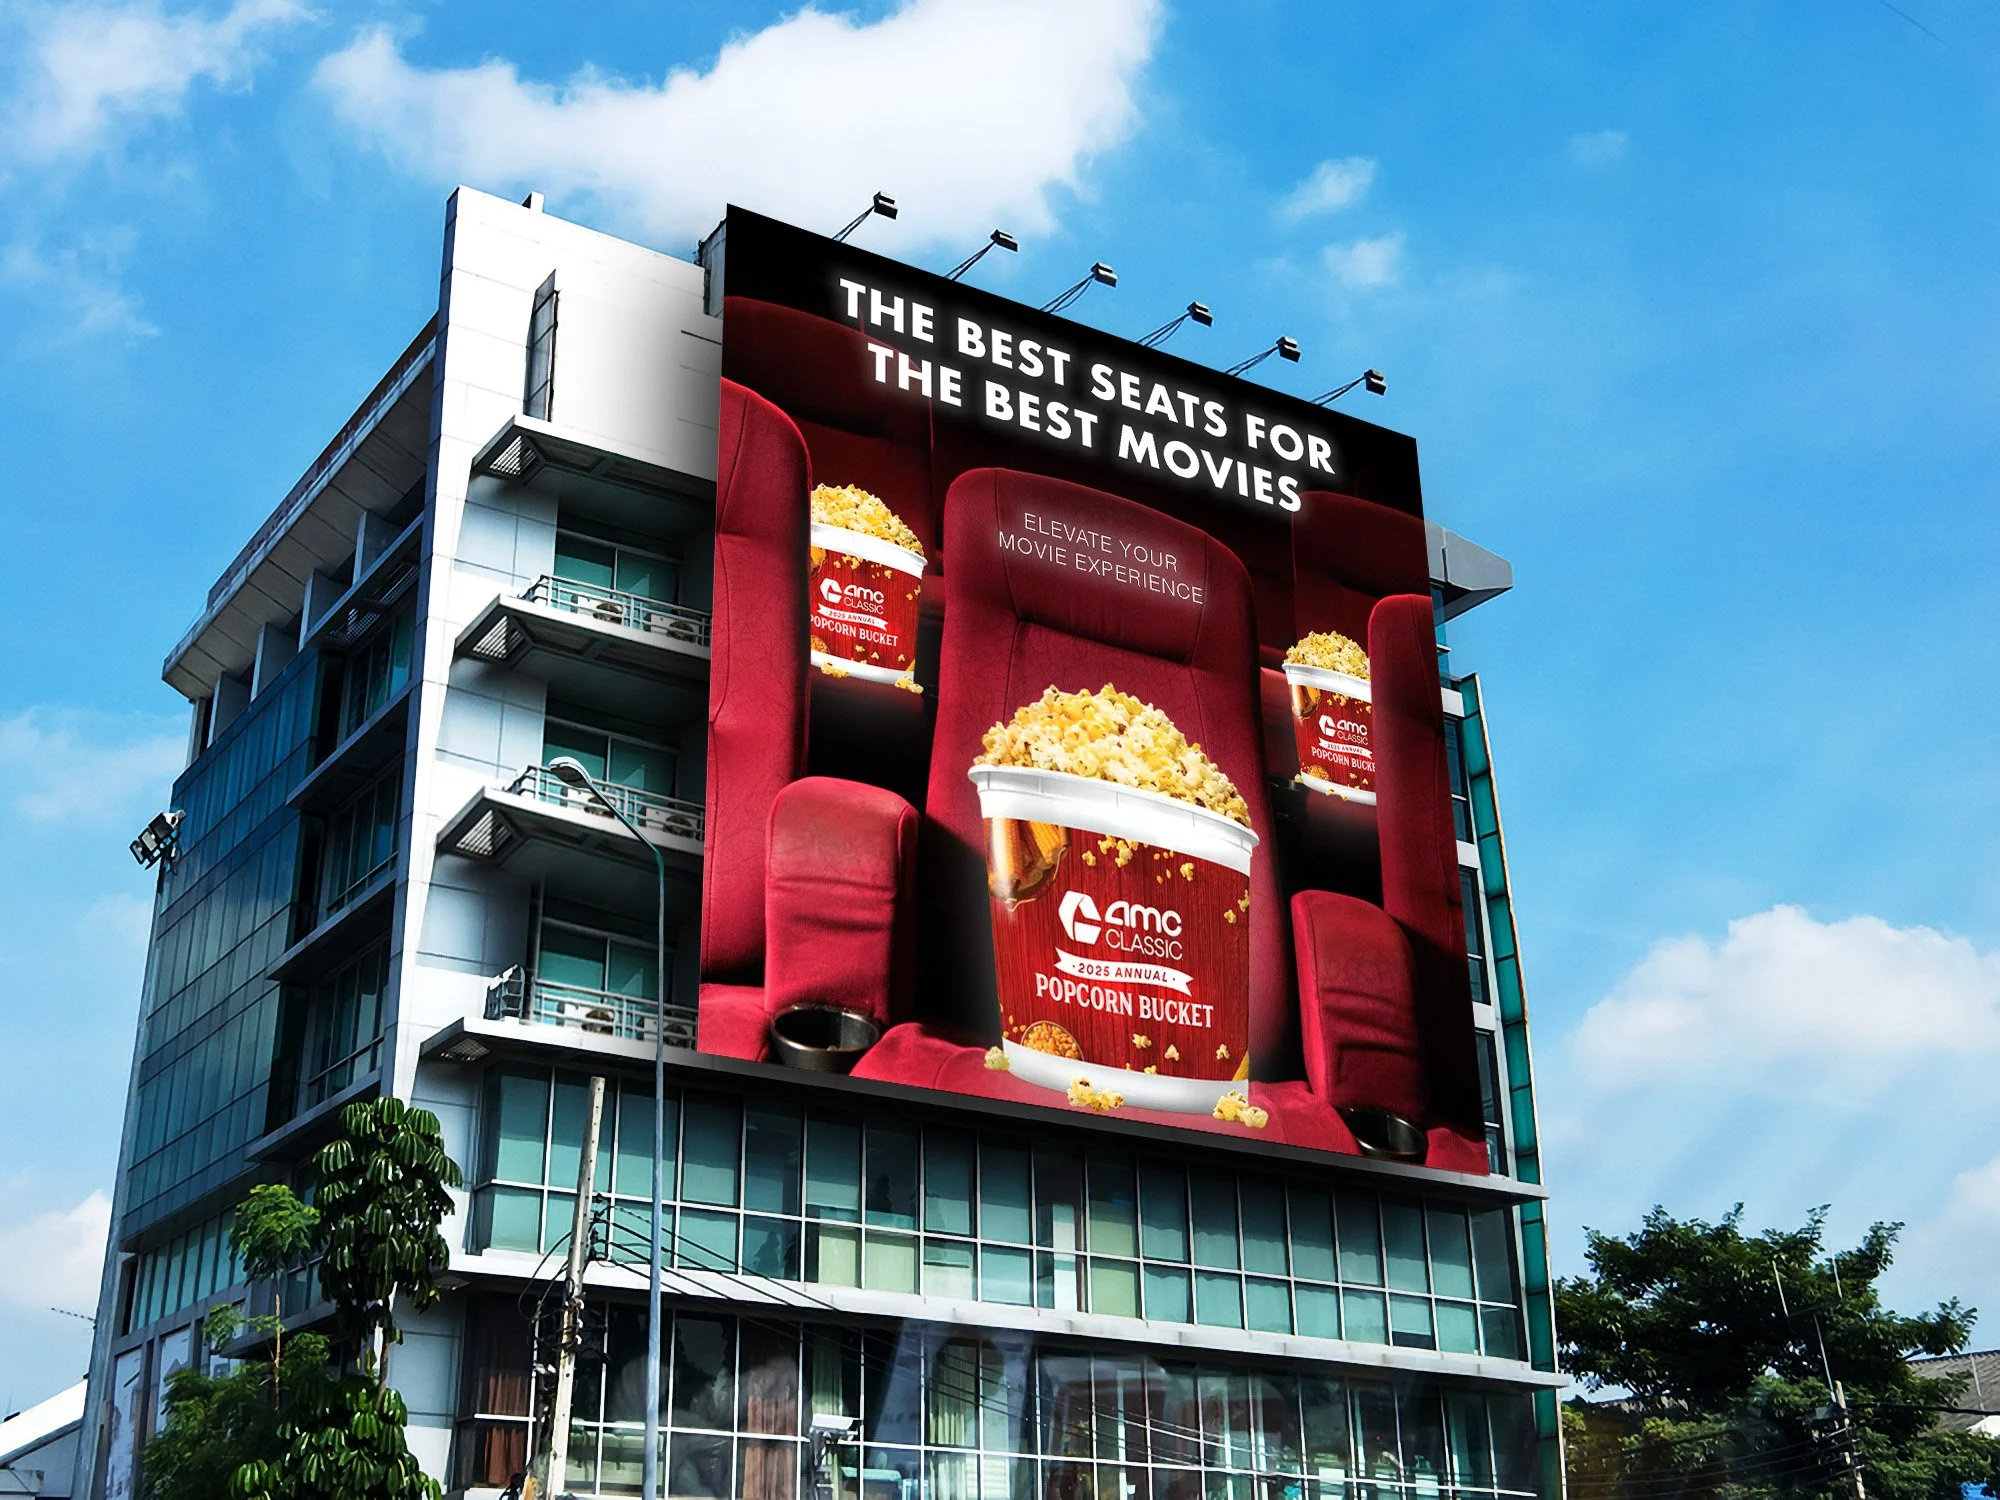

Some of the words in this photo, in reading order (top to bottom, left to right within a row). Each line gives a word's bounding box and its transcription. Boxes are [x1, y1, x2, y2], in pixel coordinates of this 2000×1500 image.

[839, 277, 935, 343] THE
[957, 316, 1070, 387] BEST
[1090, 362, 1228, 437] SEATS
[1246, 413, 1336, 475] FOR
[867, 342, 962, 407] THE
[985, 379, 1098, 448] BEST
[1118, 424, 1303, 513] MOVIES
[1024, 512, 1113, 554] ELEVATE
[1119, 540, 1178, 572] YOUR
[999, 530, 1067, 566] MOVIE
[1075, 552, 1204, 605] EXPERIENCE
[843, 596, 885, 615] CLASSIC
[847, 614, 876, 625] ANNUAL
[859, 627, 899, 647] BUCKET
[1336, 730, 1369, 746] CLASSIC
[1311, 745, 1350, 767] POPCORN
[1105, 928, 1183, 961] CLASSIC
[1078, 962, 1110, 977] 2025
[1114, 966, 1169, 983] ANNUAL
[1035, 972, 1133, 1016] POPCORN
[1138, 994, 1214, 1028] BUCKET
